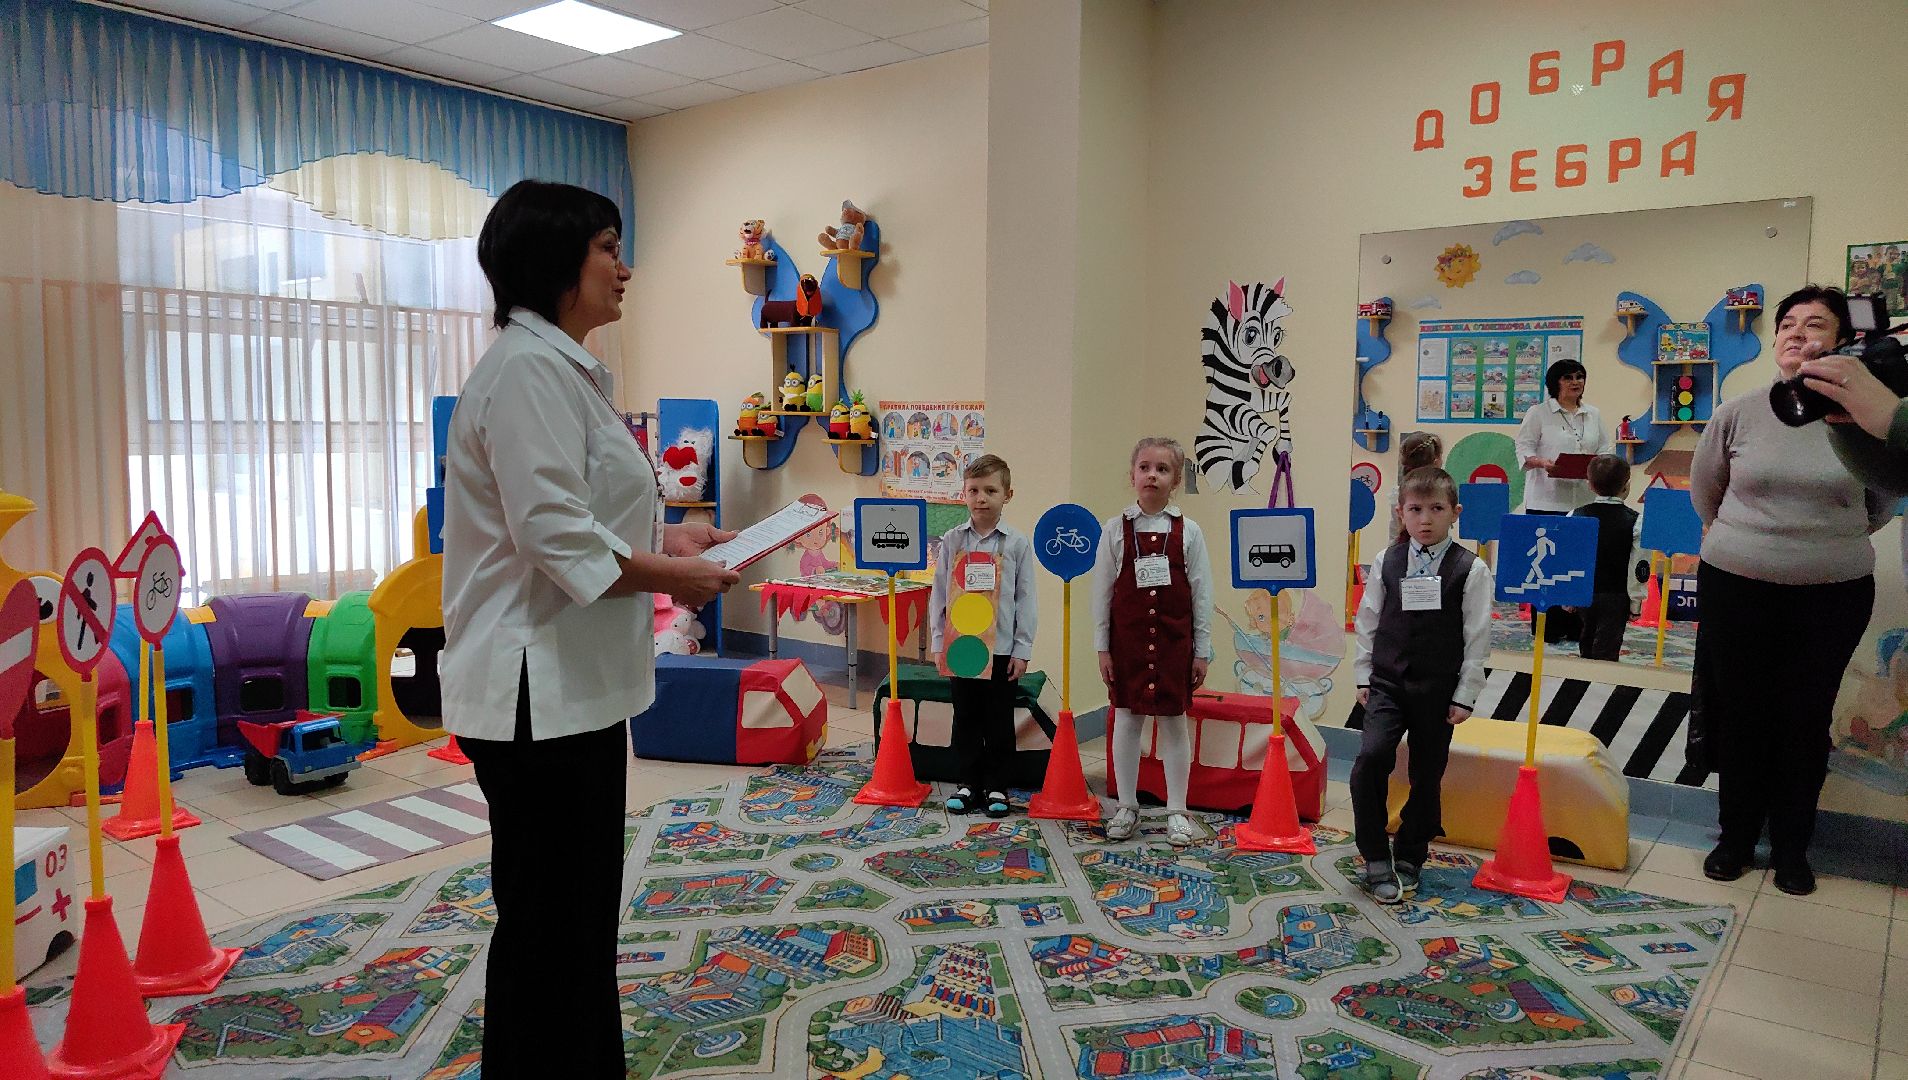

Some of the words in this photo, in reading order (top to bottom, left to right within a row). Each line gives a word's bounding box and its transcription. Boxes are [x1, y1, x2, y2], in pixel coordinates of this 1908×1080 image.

[1413, 39, 1746, 152] ДОБРАЯ
[1462, 130, 1698, 199] ЗЕБРА
[45, 843, 68, 878] 03
